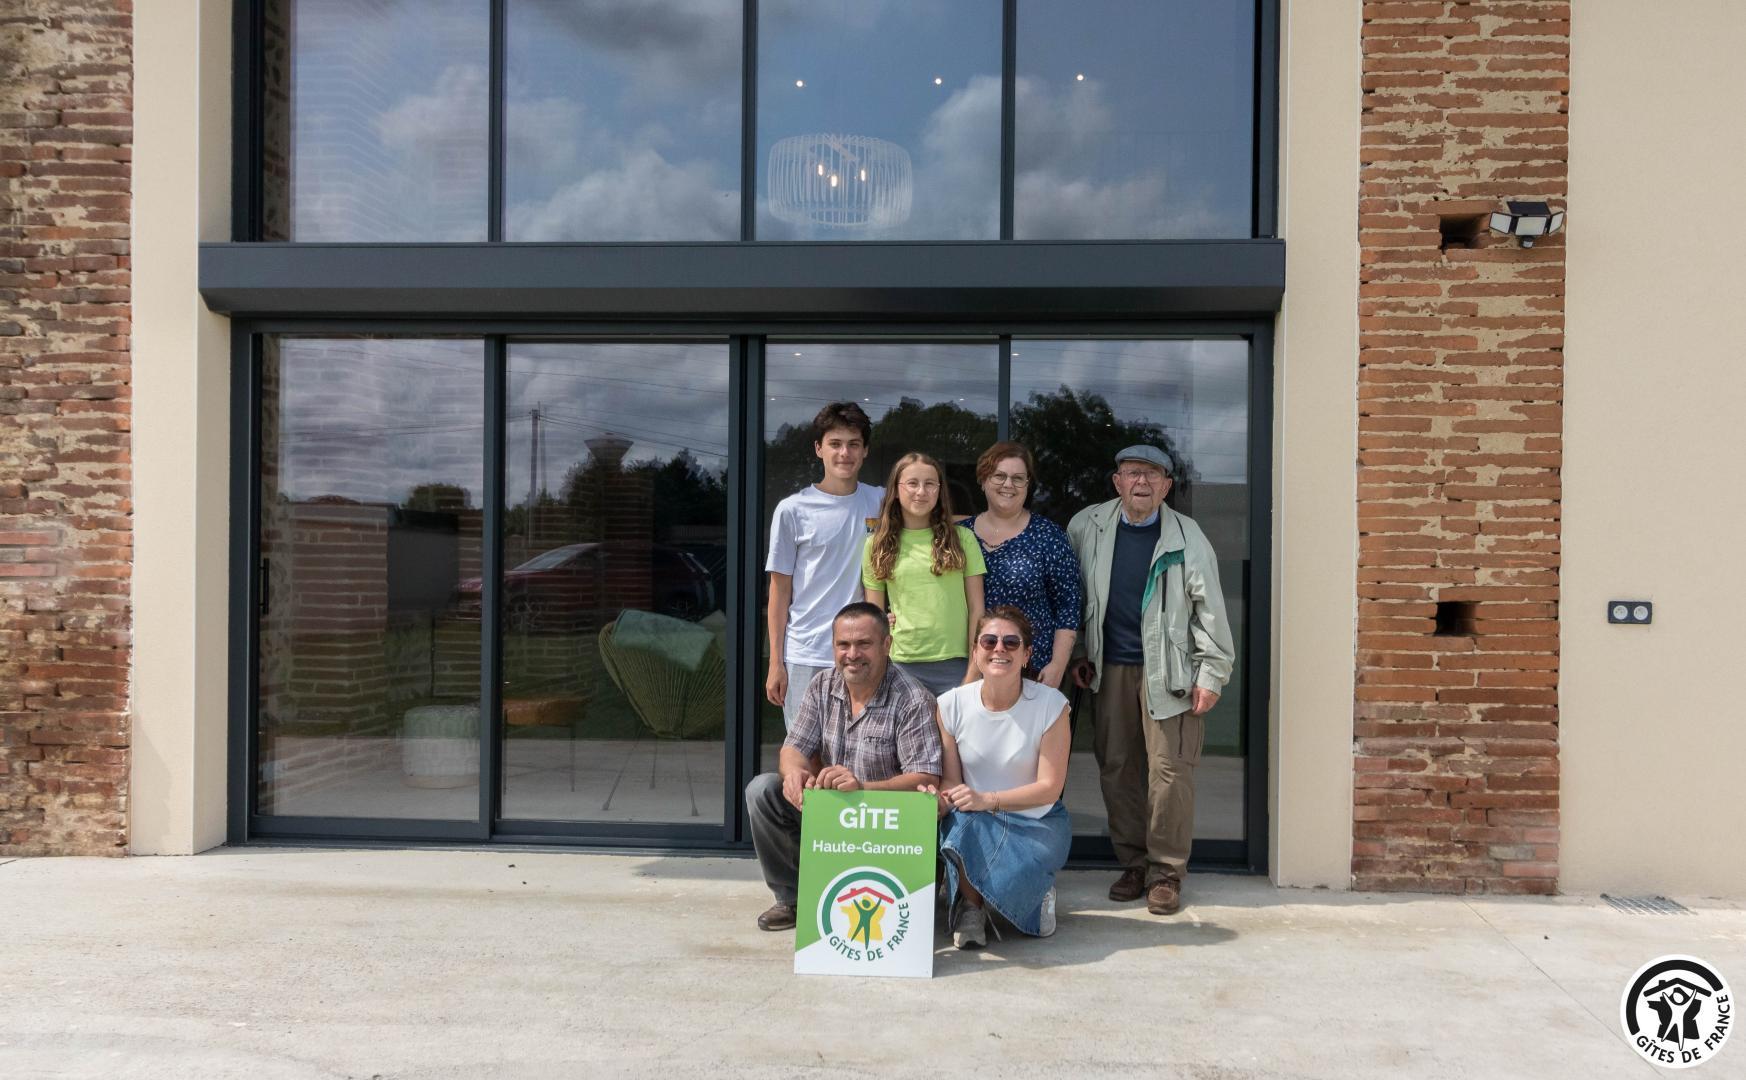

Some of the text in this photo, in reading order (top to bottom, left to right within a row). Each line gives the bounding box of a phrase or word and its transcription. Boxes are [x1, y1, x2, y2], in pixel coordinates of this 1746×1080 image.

[839, 802, 899, 830] GÎTE
[812, 839, 923, 855] Haute-Garonne
[829, 902, 910, 961] GÎTES DE FRANCE
